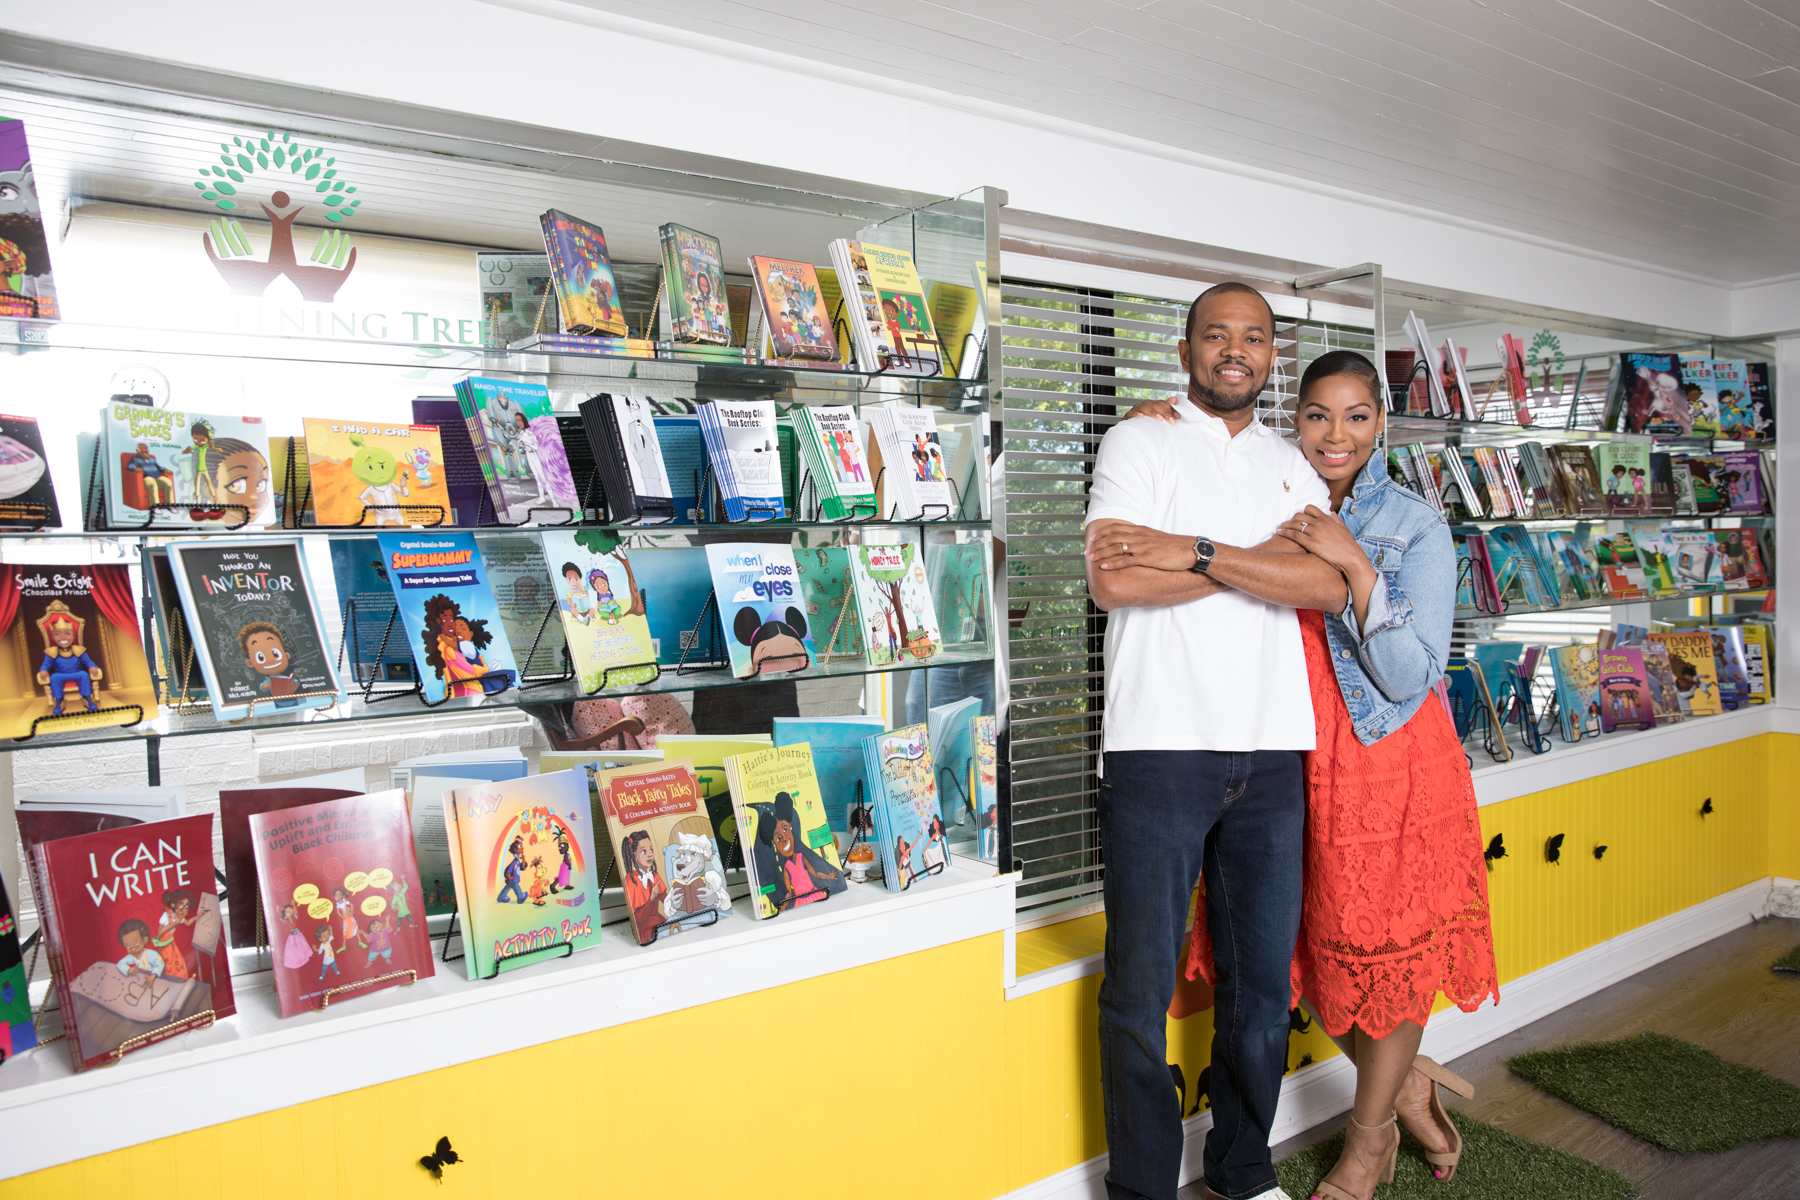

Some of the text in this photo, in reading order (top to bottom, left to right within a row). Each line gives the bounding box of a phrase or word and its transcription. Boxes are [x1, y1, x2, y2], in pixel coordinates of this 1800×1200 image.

[675, 229, 720, 264] MELTREK
[768, 261, 806, 275] MELTREK
[674, 343, 702, 351] MELTREK
[675, 353, 703, 361] MELTREK
[474, 383, 547, 397] NANDI: TIME TRAVELER
[114, 404, 185, 428] GRANDPA'S
[720, 408, 751, 420] The Rooftop
[814, 413, 851, 423] The Rooftop Club
[342, 424, 368, 436] HAD
[371, 426, 381, 435] A
[385, 428, 410, 437] CAR
[727, 419, 761, 427] Book Series:
[130, 421, 172, 441] SHOES
[400, 541, 420, 549] Crystal
[244, 552, 259, 560] YOU
[392, 549, 473, 570] SUPERMOMMY
[726, 555, 756, 567] when
[886, 556, 901, 565] TREE
[218, 562, 271, 572] THANKED AN
[765, 563, 792, 576] close
[15, 572, 94, 590] Smile Bright
[201, 572, 294, 596] INVENTOR
[409, 577, 424, 585] Super
[424, 576, 440, 584] Single
[440, 575, 460, 584] Mommy
[234, 593, 271, 602] TODAY?
[752, 580, 793, 603] eyes
[595, 625, 627, 638] BIG BOOK
[593, 635, 635, 650] OF BEGINNER
[1651, 635, 1709, 647] MY DADDY
[589, 645, 644, 662] READING STORIES
[1602, 654, 1628, 663] Brown
[1690, 646, 1712, 658] ME
[1601, 664, 1635, 674] Girls Club
[229, 685, 251, 693] PATRICE
[908, 741, 923, 756] Book
[742, 748, 774, 775] Hattie's
[776, 747, 811, 763] Journey
[624, 773, 676, 788] CRYSTAL SWAIN-BATES
[747, 776, 770, 791] Coloring
[775, 772, 797, 784] Activity
[798, 768, 813, 779] Book
[468, 790, 502, 818] My
[616, 783, 692, 810] Black Fairy Tales
[889, 788, 918, 807] Princesses
[515, 806, 554, 822] Tell Me
[629, 809, 654, 819] COLORING
[659, 804, 679, 813] ACTIVITY
[679, 802, 692, 810] BOOK
[261, 812, 314, 841] Positive
[268, 816, 394, 851] Uplift and Empower
[520, 820, 544, 834] Who
[291, 830, 377, 855] Black Children
[529, 831, 549, 846] AM
[89, 835, 182, 879] I CAN
[86, 860, 191, 908] WRITE
[494, 915, 592, 961] ACTIVITY BOOK
